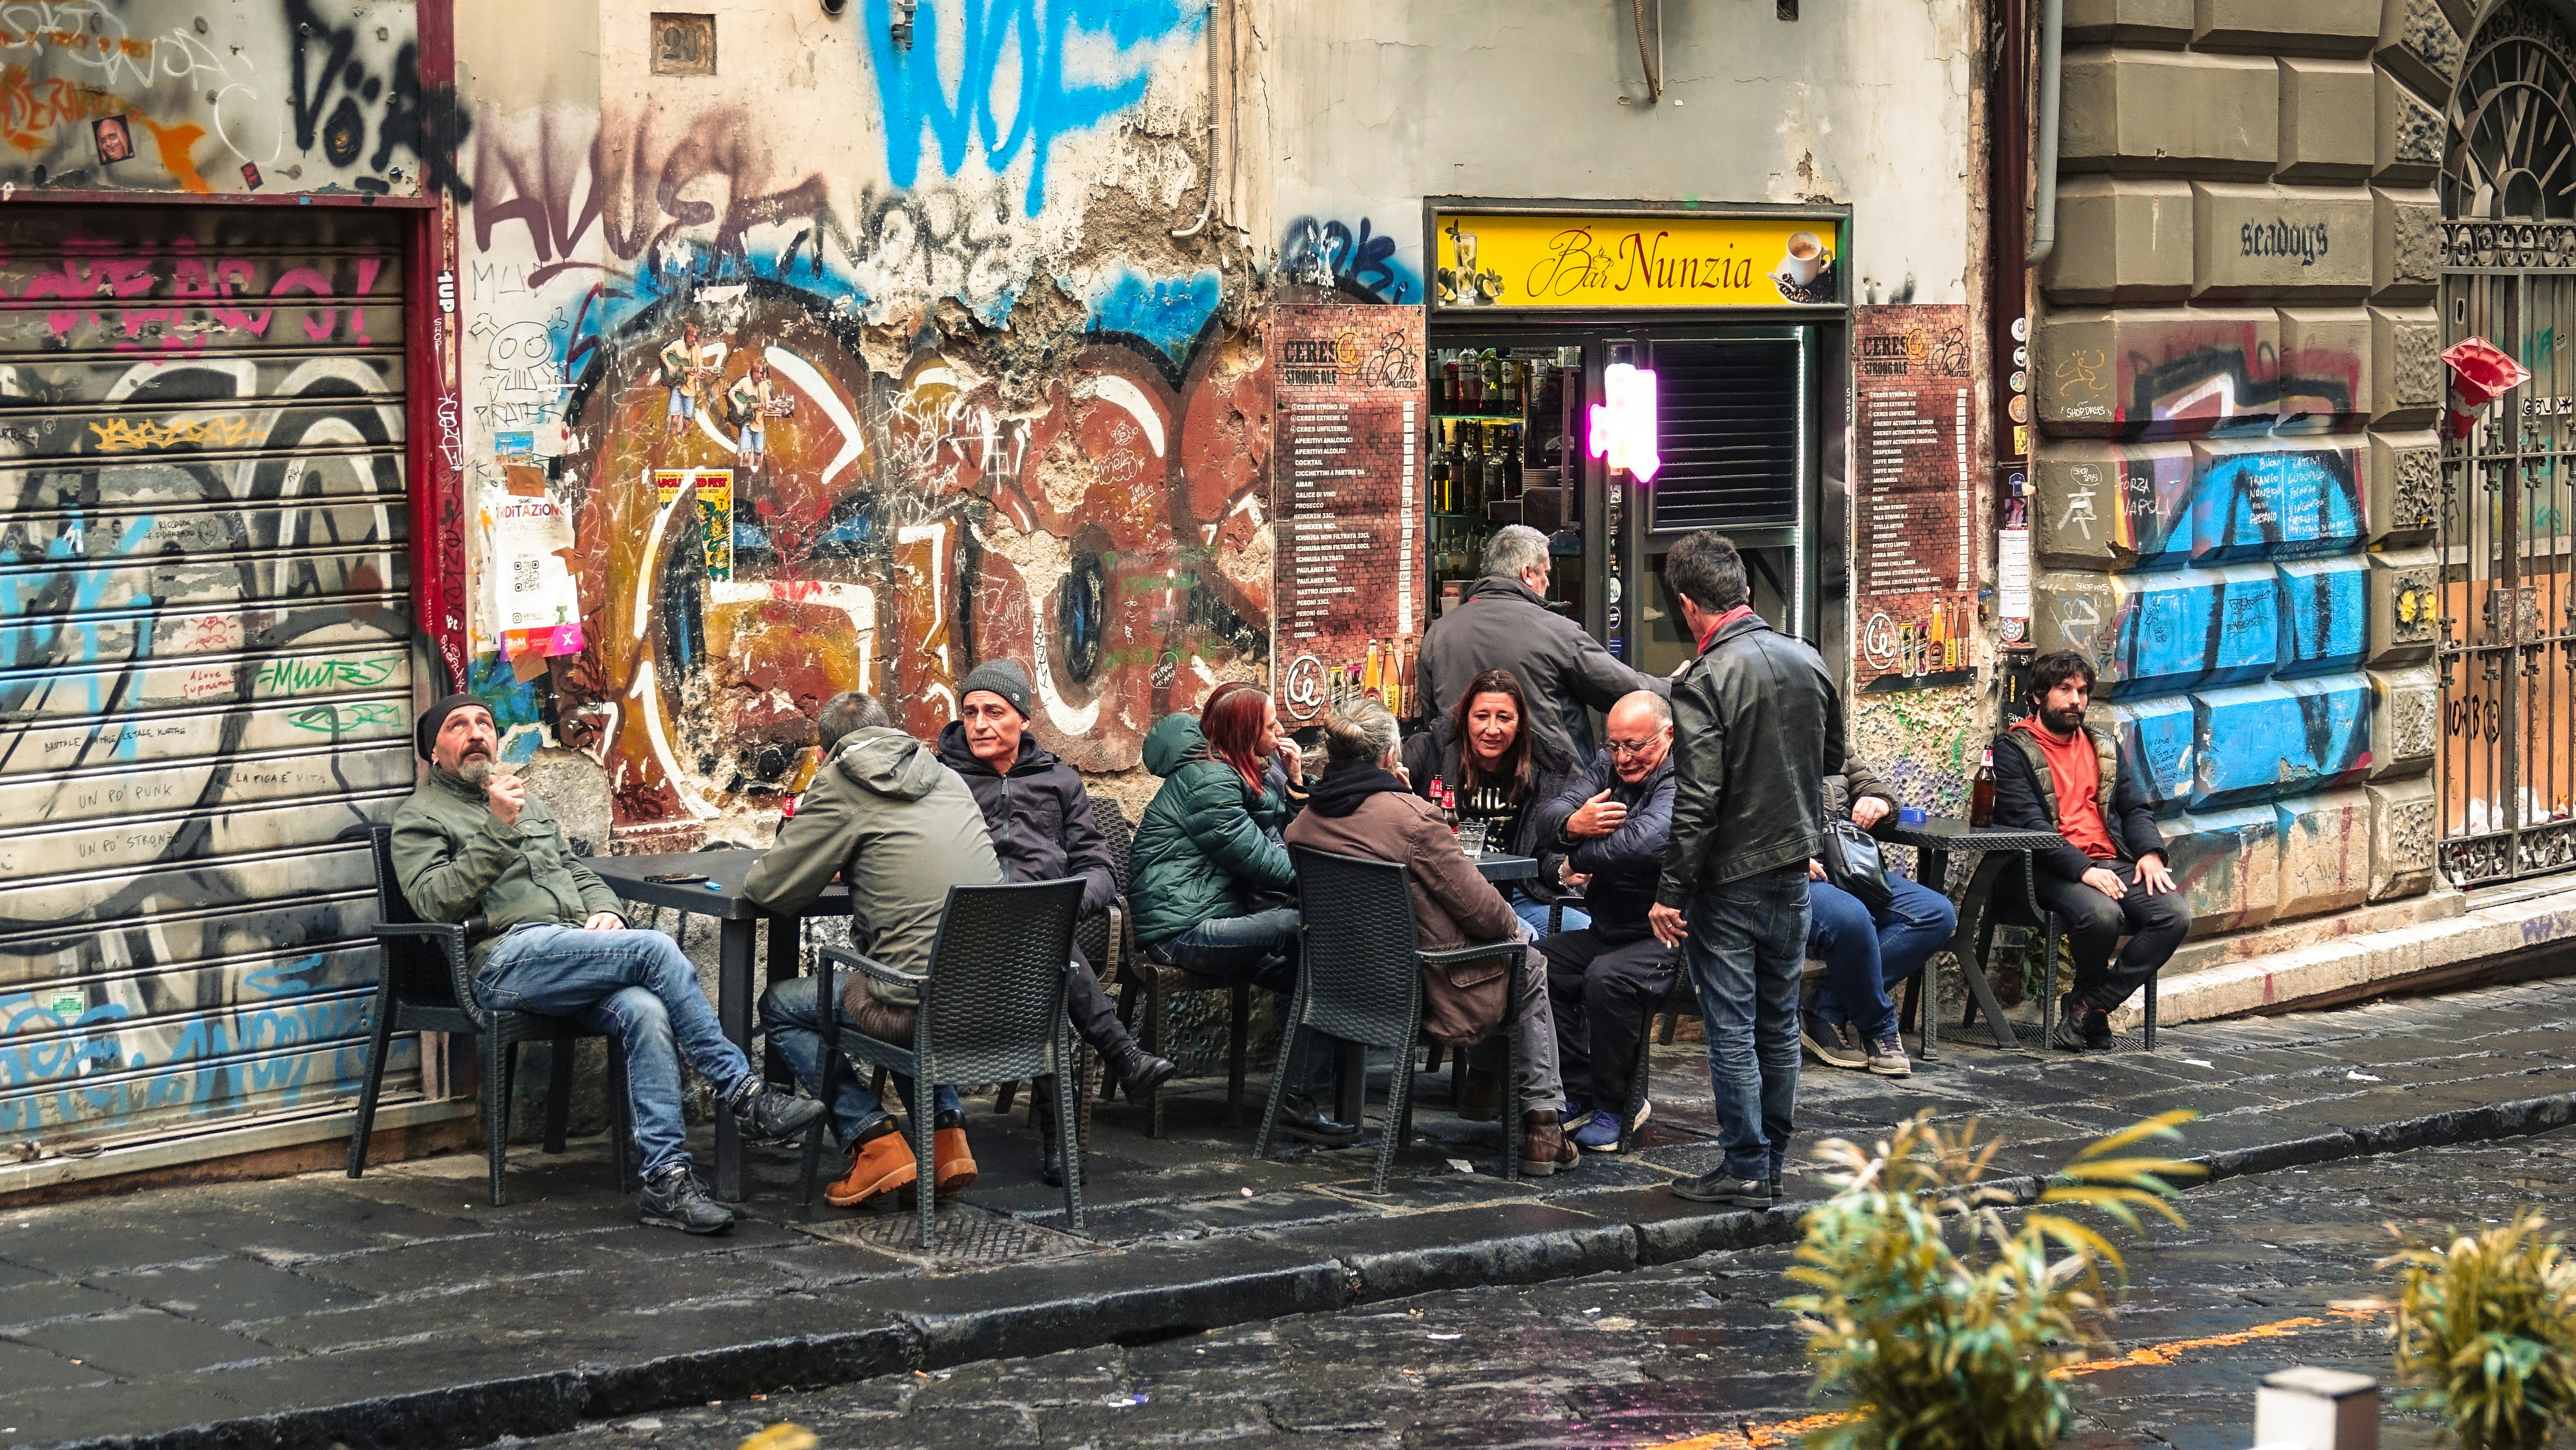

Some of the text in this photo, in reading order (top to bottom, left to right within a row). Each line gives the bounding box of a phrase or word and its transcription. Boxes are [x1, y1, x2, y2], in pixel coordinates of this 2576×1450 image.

[1526, 226, 1753, 297] Bar Nunzia
[437, 271, 455, 313] 1UP
[1284, 339, 1337, 363] CERES
[1864, 337, 1909, 355] CERES
[1864, 362, 1908, 374] STRONG ALE
[1286, 369, 1336, 385] STRONG ALE
[708, 478, 727, 487] FEST
[236, 773, 248, 782] LA
[254, 771, 277, 782] FIGA
[79, 790, 97, 808] UN
[136, 783, 172, 799] PUNK
[80, 842, 96, 857] UN
